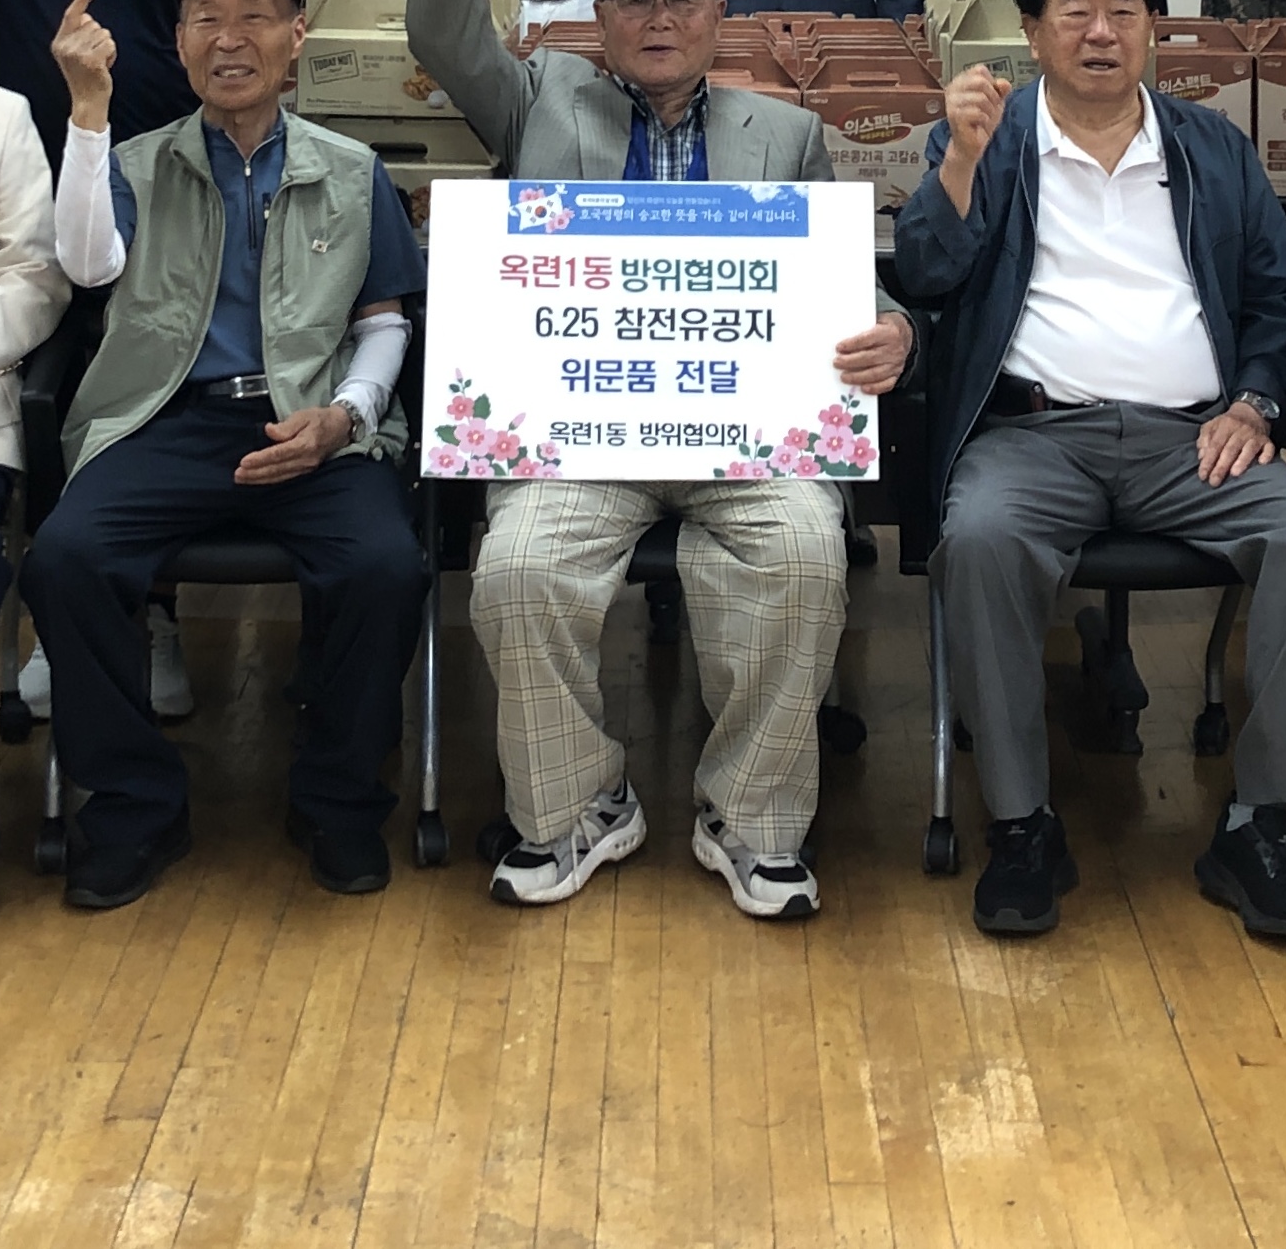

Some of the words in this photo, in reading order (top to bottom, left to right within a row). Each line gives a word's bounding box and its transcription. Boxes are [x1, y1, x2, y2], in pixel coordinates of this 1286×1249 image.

[843, 112, 903, 136] 위스펙트
[889, 150, 920, 164] 고칼슘
[701, 208, 724, 223] 가슴
[728, 208, 749, 223] 깊이
[752, 208, 800, 223] 새깁니다.
[499, 254, 613, 290] 옥련1동
[621, 258, 778, 294] 방위협의회
[535, 306, 600, 339] 6.25
[614, 307, 776, 342] 참전유공자
[560, 358, 657, 393] 위문품
[675, 359, 740, 394] 전달
[549, 421, 627, 447] 옥련1동
[639, 422, 748, 448] 방위협의회
